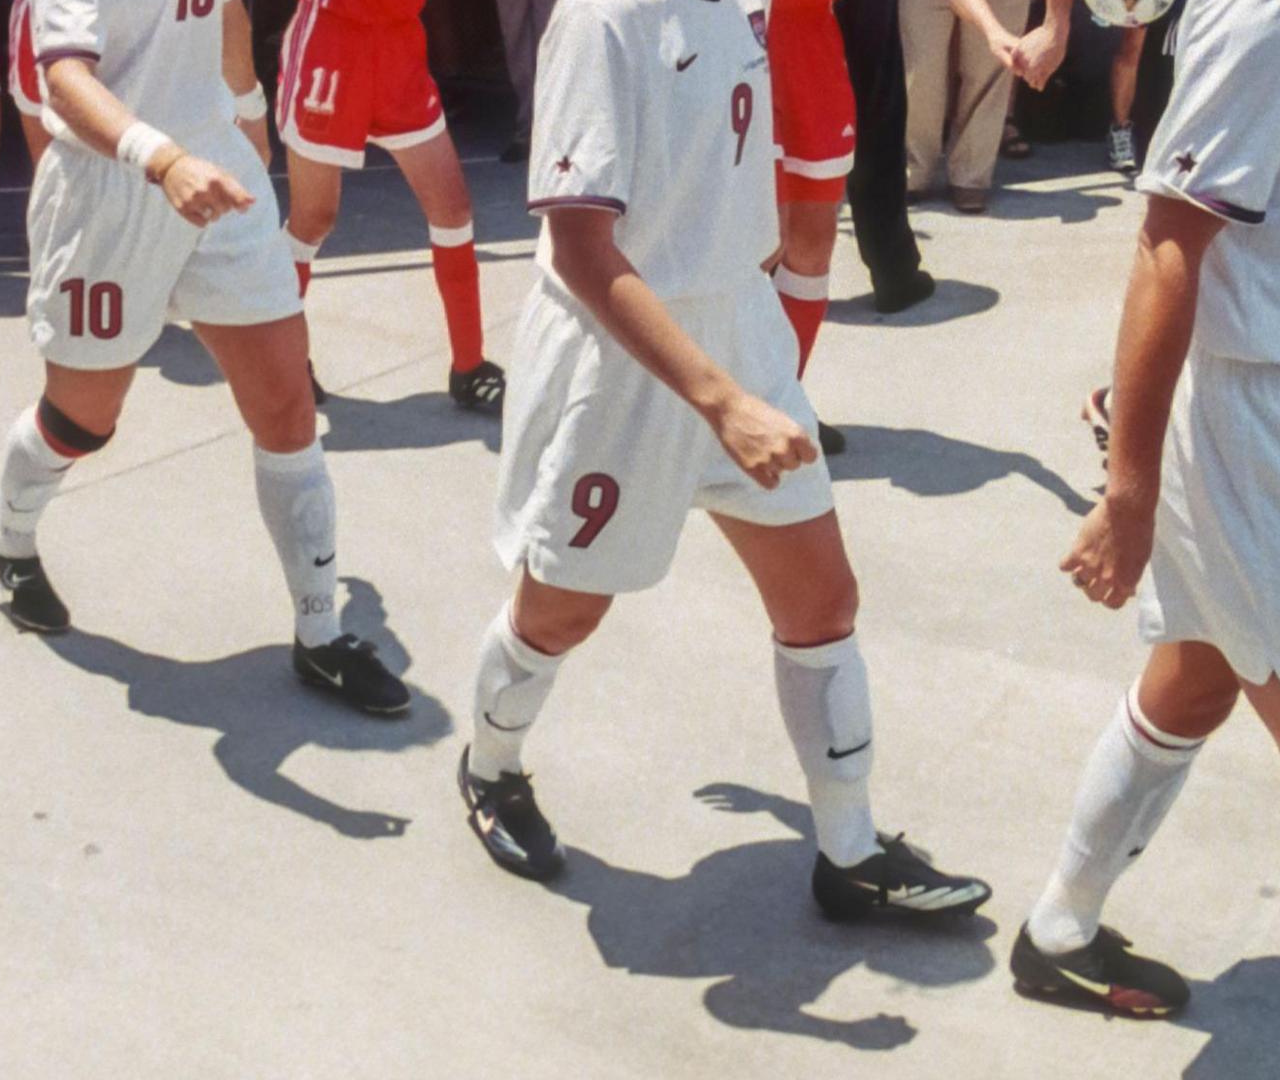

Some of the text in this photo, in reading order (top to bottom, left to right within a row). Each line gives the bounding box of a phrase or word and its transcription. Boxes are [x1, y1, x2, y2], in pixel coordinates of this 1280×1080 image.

[303, 67, 340, 113] 11
[731, 82, 753, 167] 9
[59, 277, 123, 340] 10
[567, 472, 620, 550] 9
